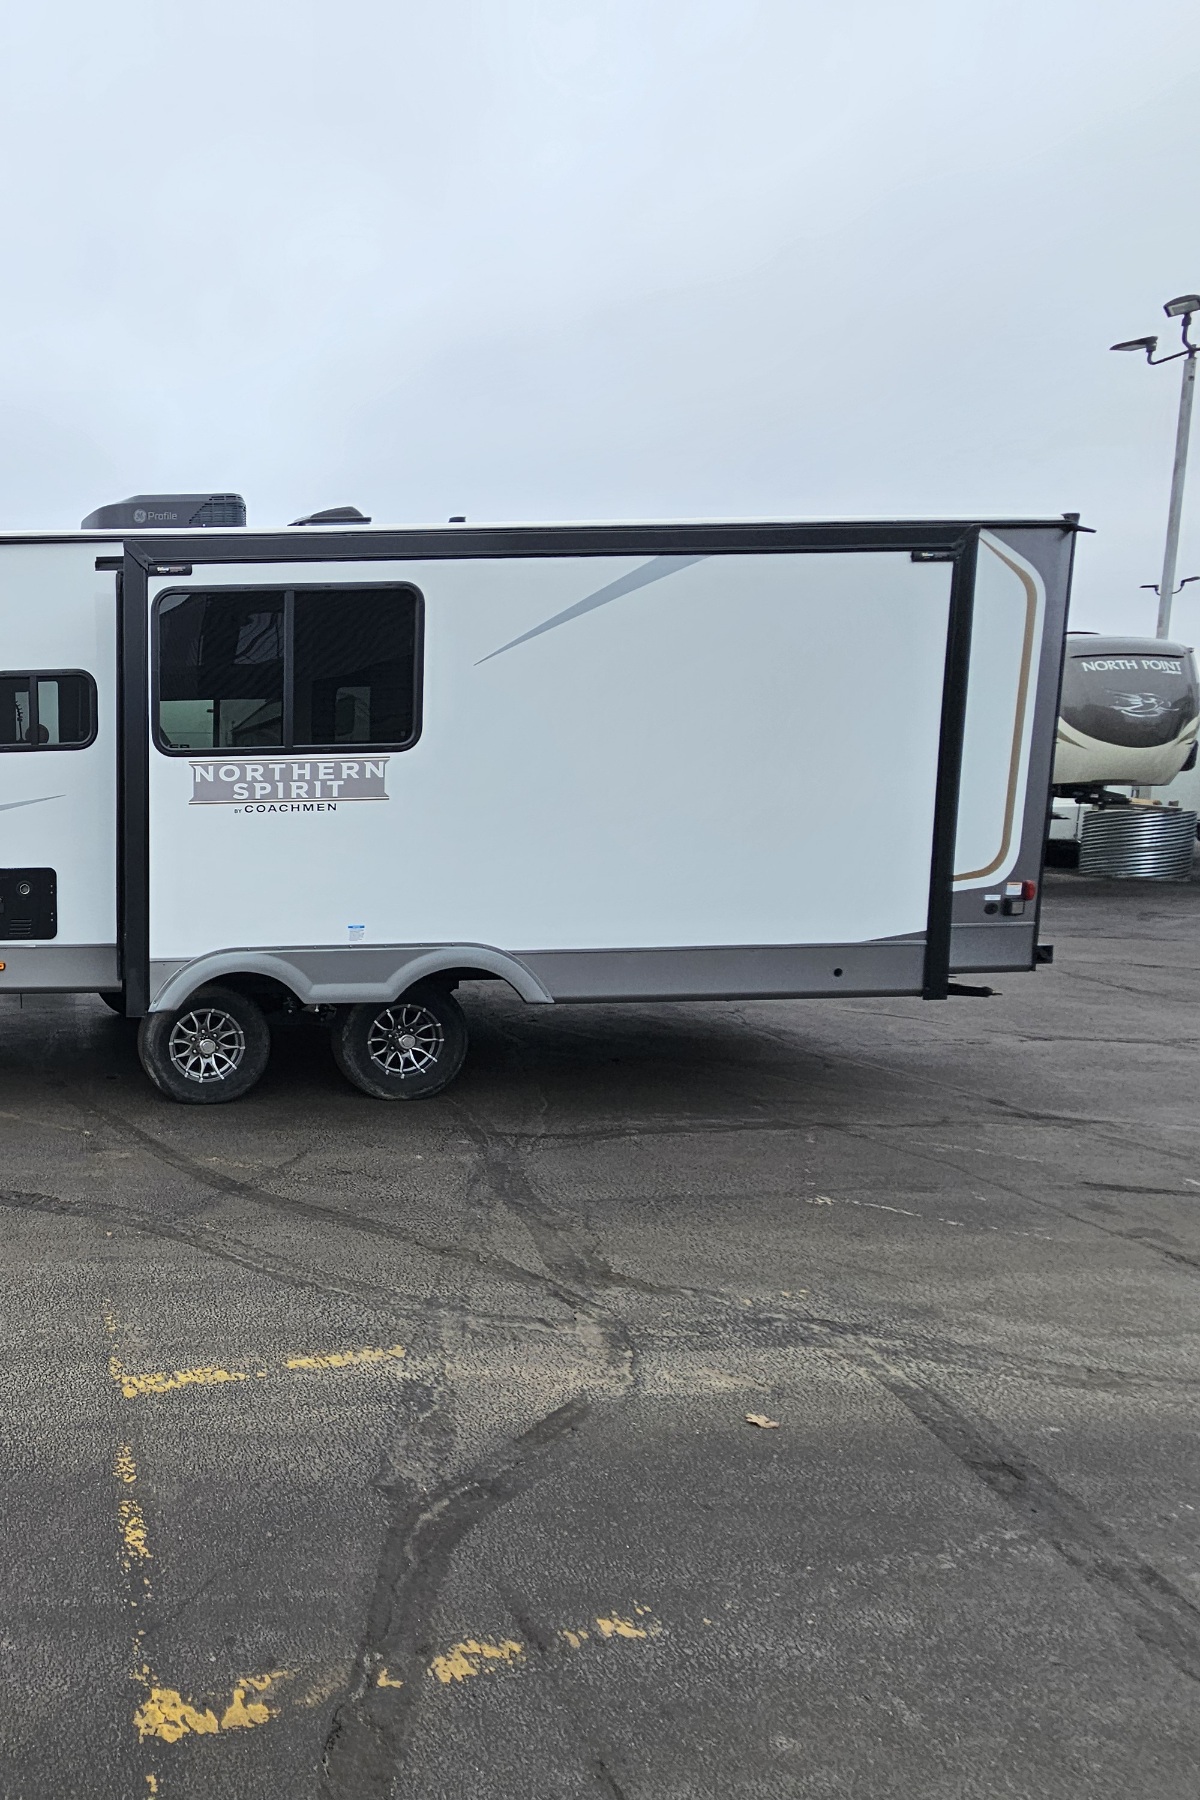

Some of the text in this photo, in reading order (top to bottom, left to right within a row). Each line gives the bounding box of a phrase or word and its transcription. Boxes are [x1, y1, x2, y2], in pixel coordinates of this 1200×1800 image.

[147, 511, 178, 520] Profile
[1081, 660, 1181, 672] NORTH POINT
[194, 761, 384, 783] NORTHERN
[232, 780, 345, 800] SPIRIT
[244, 803, 337, 813] COACHMEN
